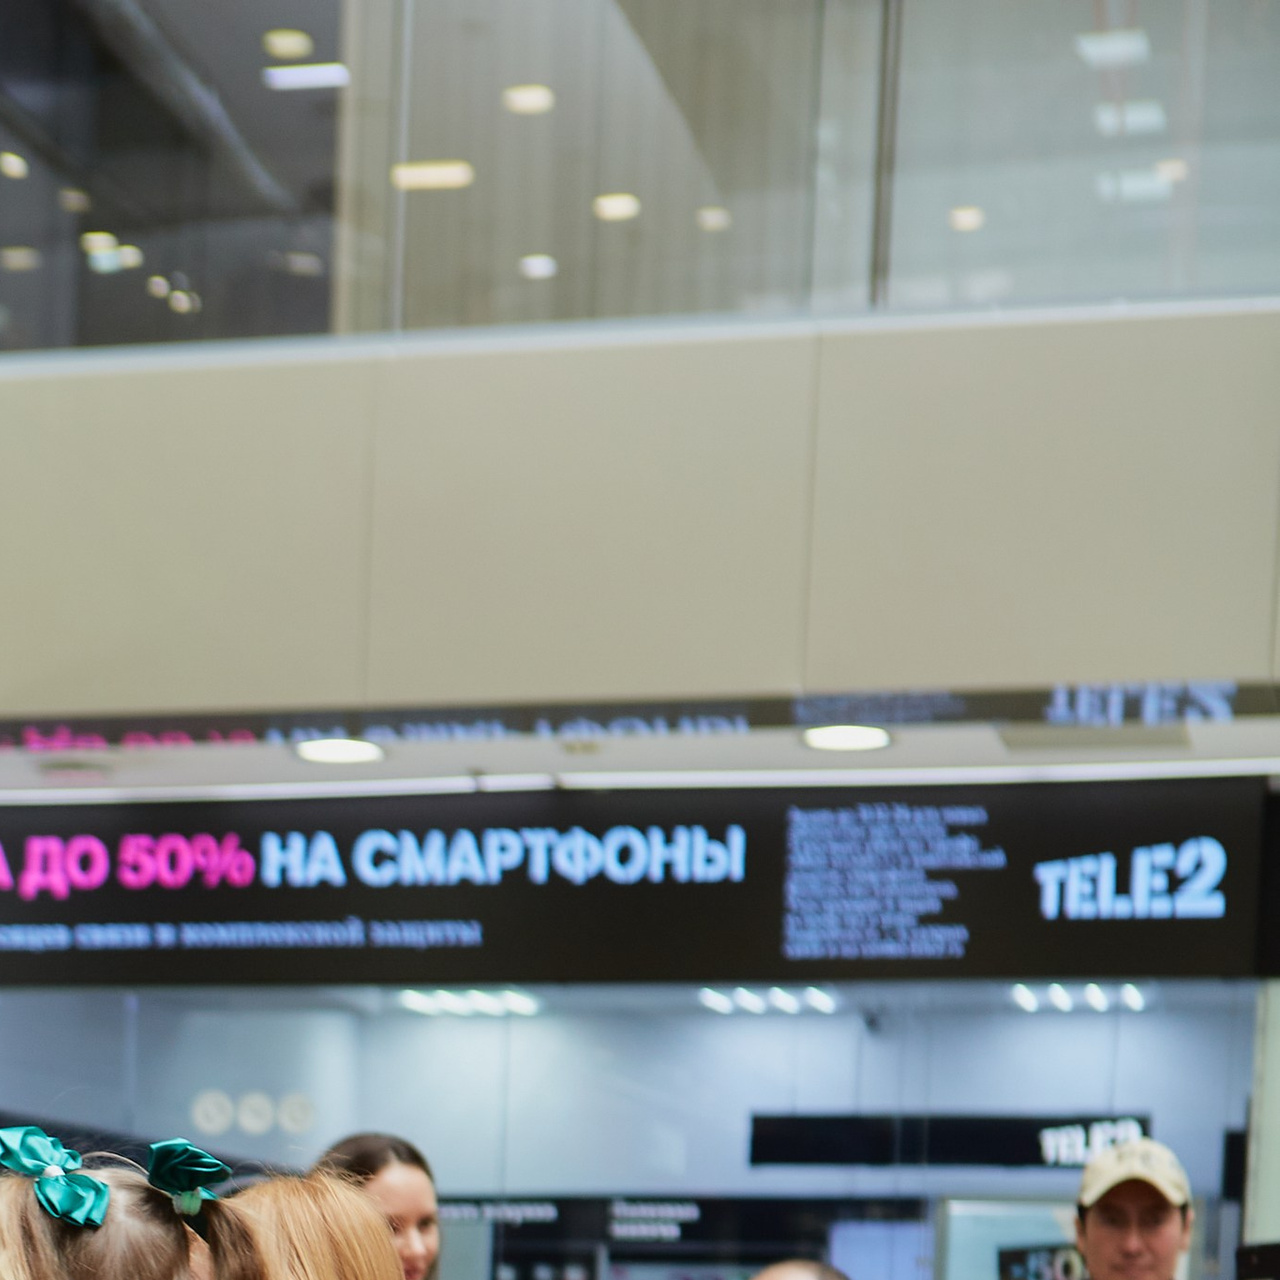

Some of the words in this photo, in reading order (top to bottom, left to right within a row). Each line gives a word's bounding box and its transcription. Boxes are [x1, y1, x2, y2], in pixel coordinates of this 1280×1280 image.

[20, 834, 109, 899] ДО
[120, 833, 255, 889] 50%
[261, 830, 345, 887] НА
[352, 824, 746, 888] СМАРТФОНЫ
[1034, 835, 1227, 919] TELE2
